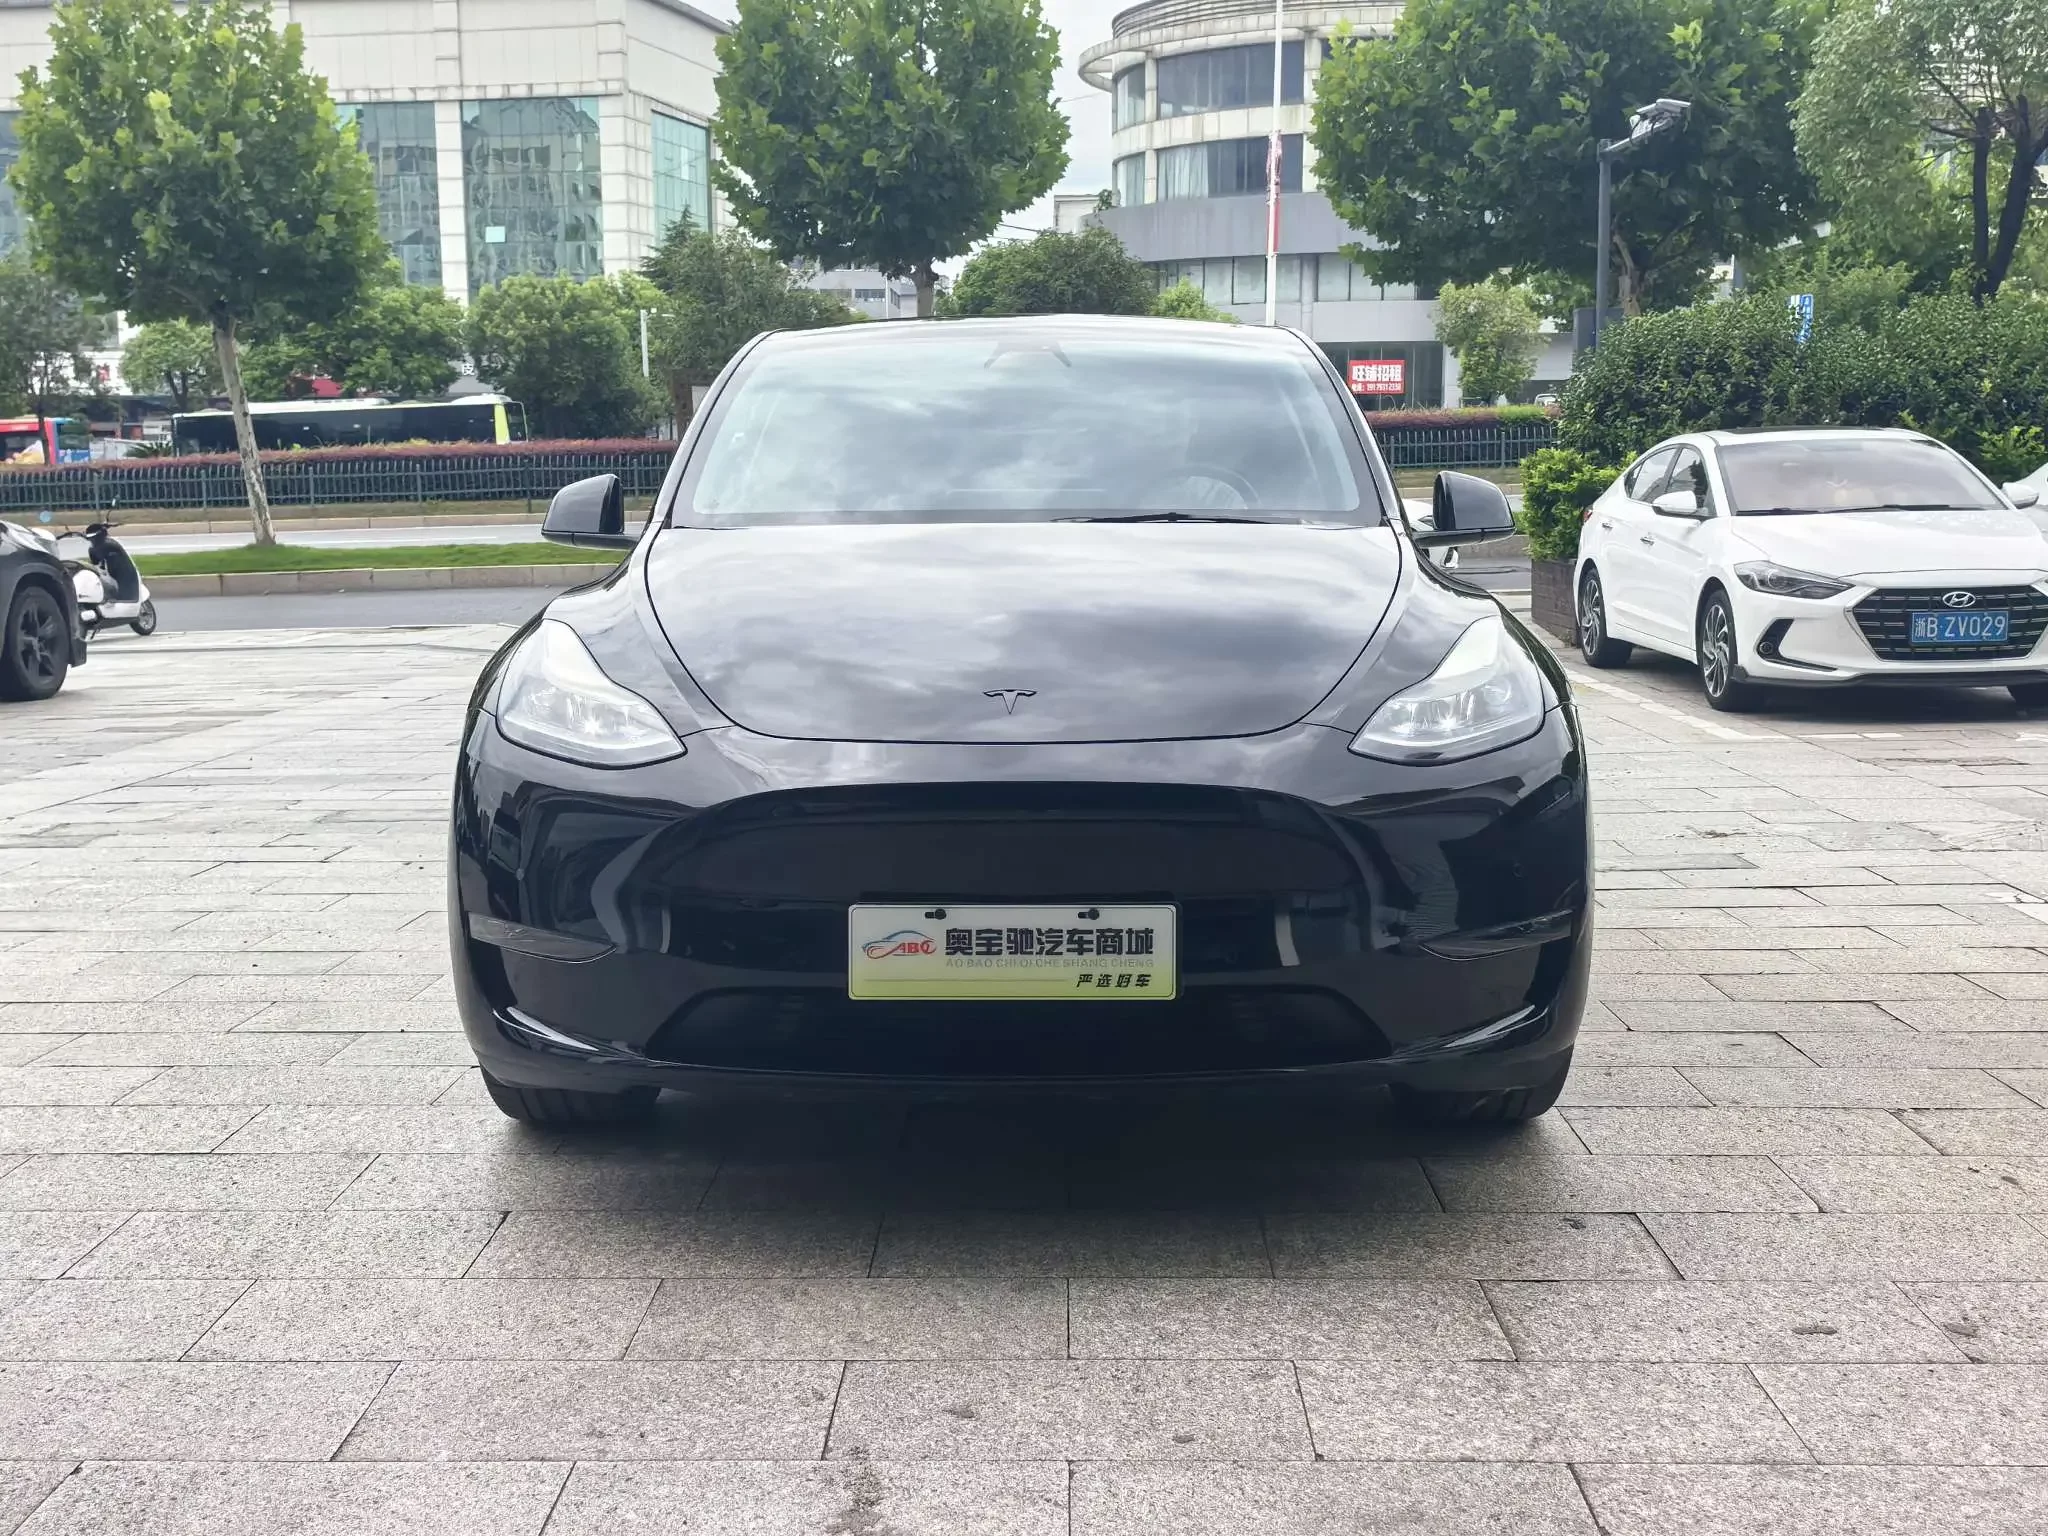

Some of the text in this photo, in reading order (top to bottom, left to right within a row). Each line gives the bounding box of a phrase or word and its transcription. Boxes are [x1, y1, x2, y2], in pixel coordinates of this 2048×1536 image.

[1352, 364, 1402, 382] 旺铺招租
[945, 928, 1154, 956] 奥宝驰汽车商城
[945, 958, 963, 968] AO
[967, 958, 993, 968] BAO
[1063, 958, 1108, 968] SHANG
[1111, 958, 1154, 968] CHENG
[1076, 973, 1152, 988] 严选好车
